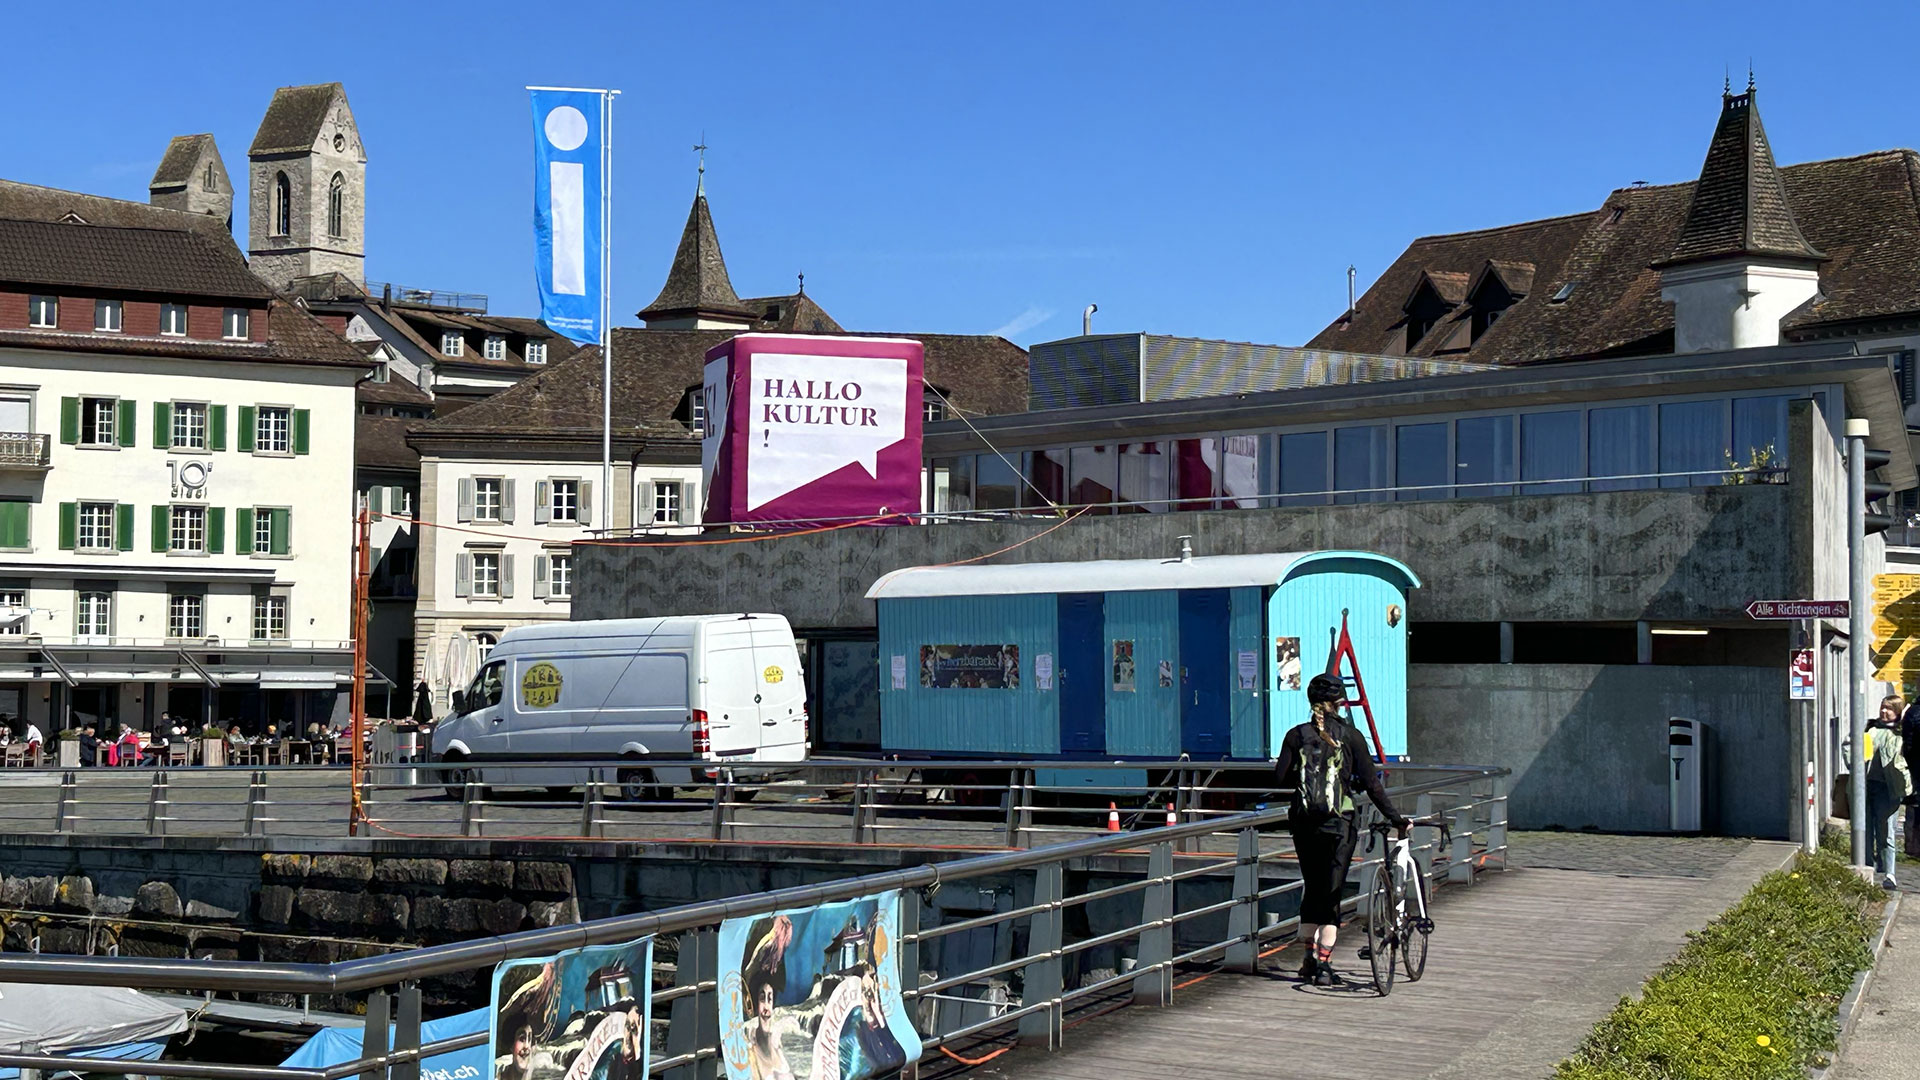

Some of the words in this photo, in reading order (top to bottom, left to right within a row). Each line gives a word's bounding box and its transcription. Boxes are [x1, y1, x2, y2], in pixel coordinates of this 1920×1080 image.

[763, 378, 862, 401] HALLO
[762, 404, 879, 427] KULTUR
[1755, 603, 1774, 615] Alle
[1777, 603, 1831, 618] Richtungen
